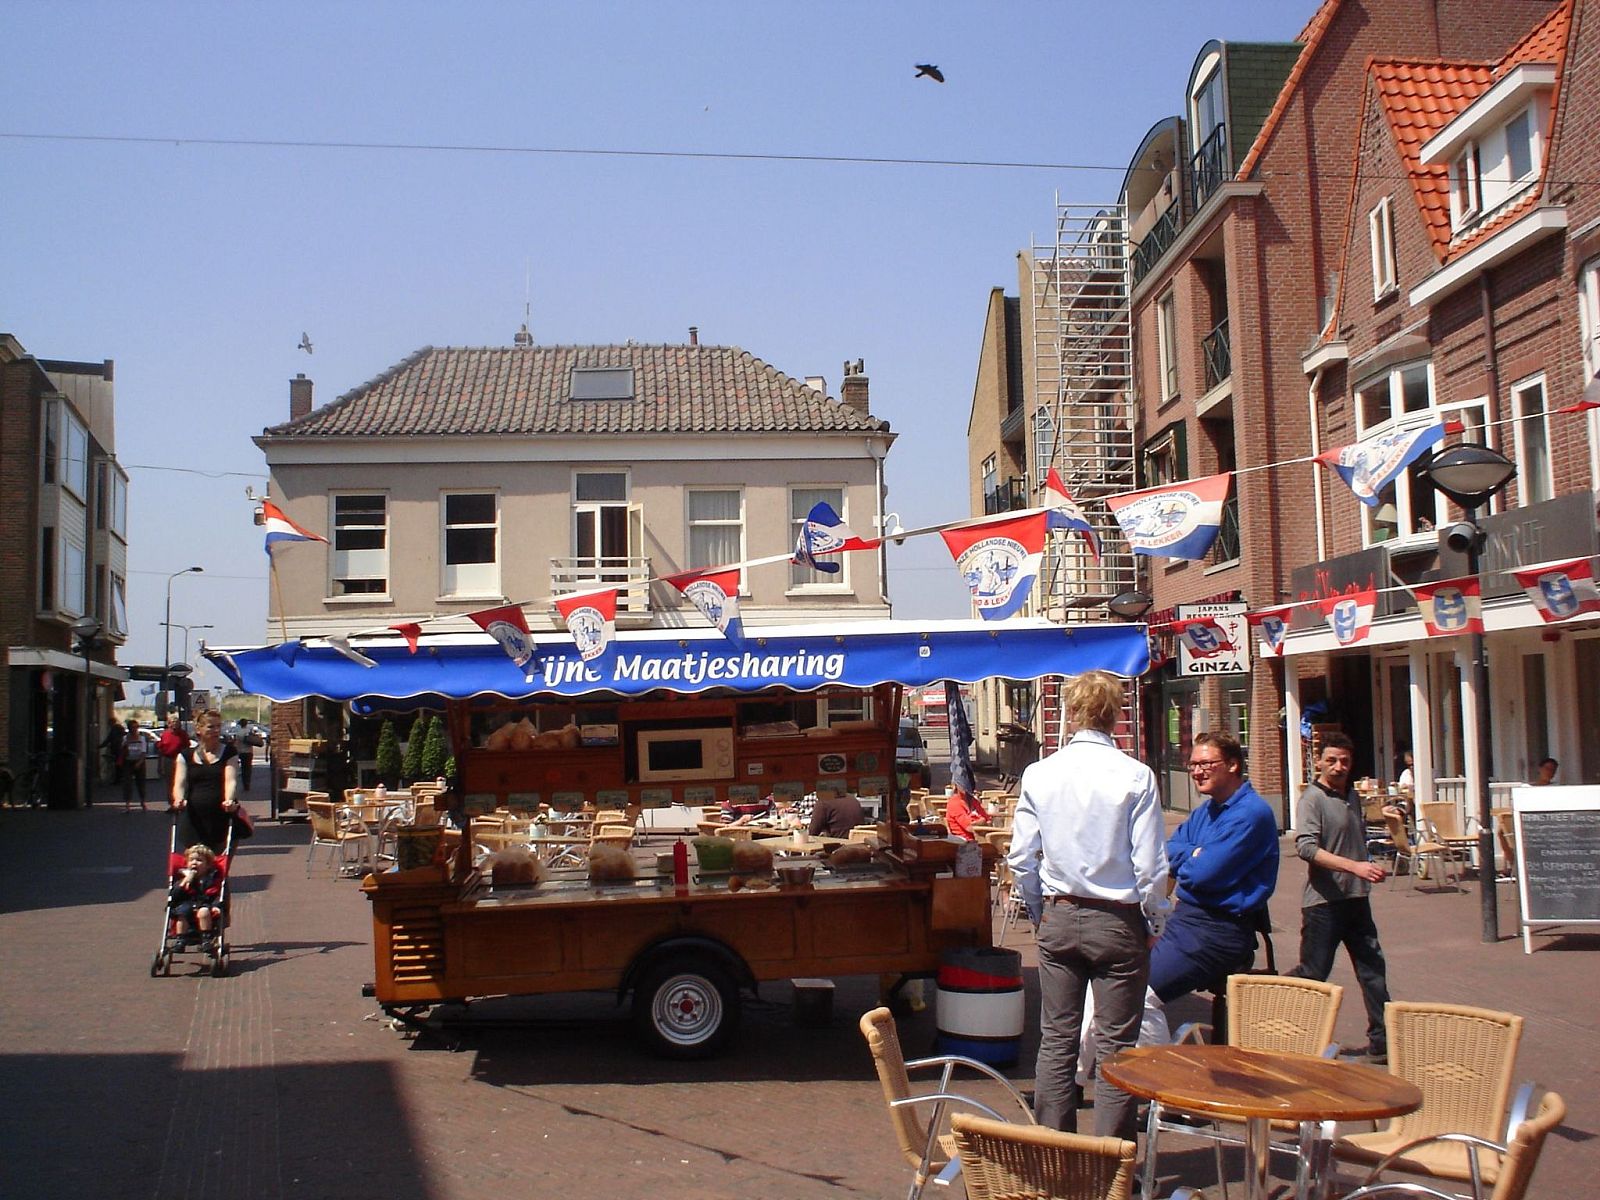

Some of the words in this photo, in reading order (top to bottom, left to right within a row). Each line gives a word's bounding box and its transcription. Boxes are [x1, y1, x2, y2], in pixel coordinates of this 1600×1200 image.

[969, 538, 1007, 554] HOLLANDSE
[1198, 605, 1230, 613] JAPANS
[525, 655, 602, 687] ijne
[613, 648, 846, 681] Maatjesharing
[1188, 661, 1243, 673] GINZA
